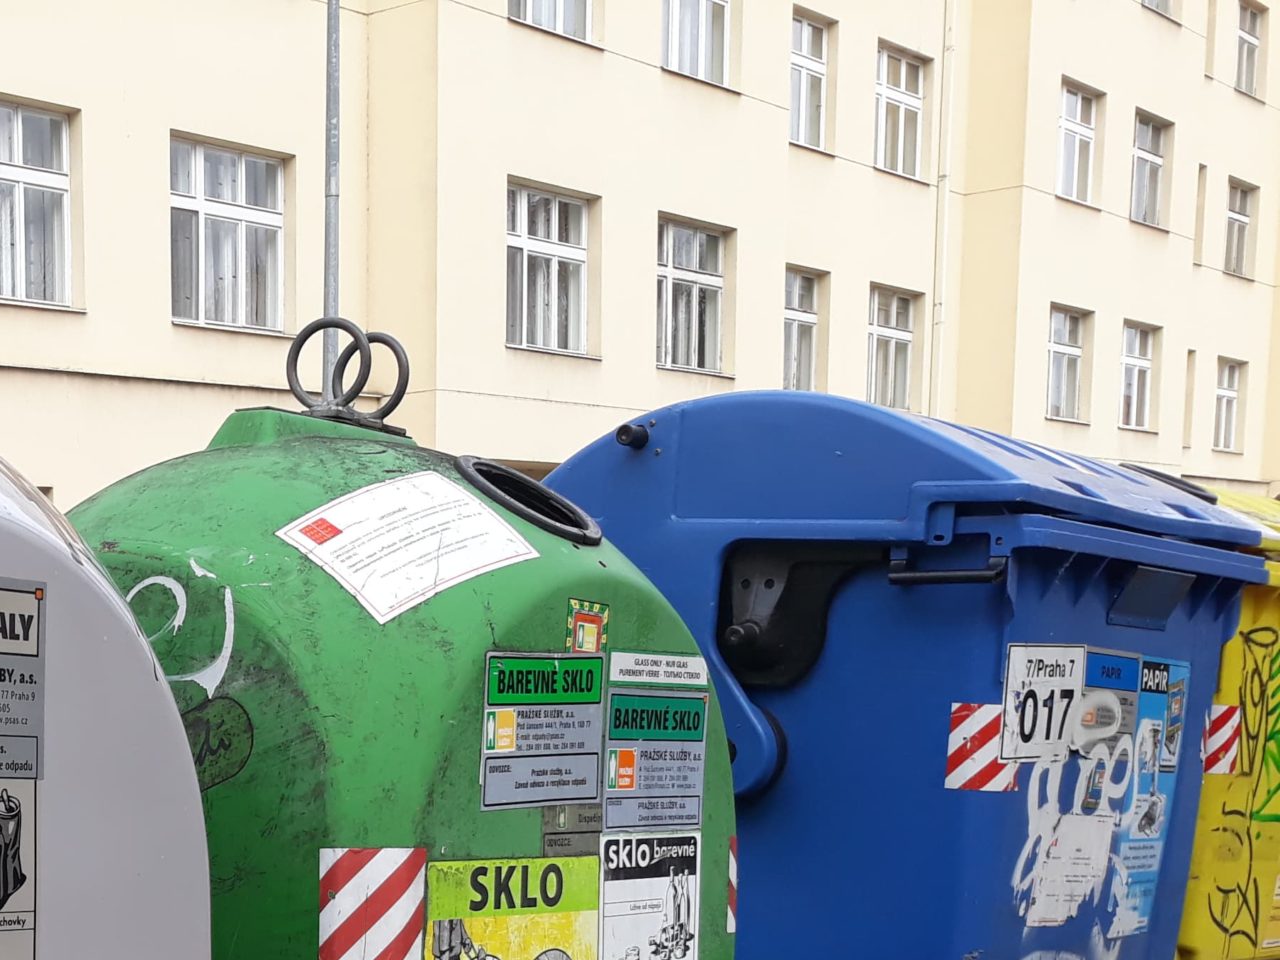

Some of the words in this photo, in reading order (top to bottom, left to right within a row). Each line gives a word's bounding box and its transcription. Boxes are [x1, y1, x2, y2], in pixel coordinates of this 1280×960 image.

[634, 658, 650, 667] GLASS
[650, 659, 662, 667] ONLY
[665, 660, 676, 668] NUR
[676, 660, 688, 669] GLAS
[1026, 659, 1066, 678] 7/Praha
[1069, 659, 1075, 678] 7
[19, 673, 37, 685] a.s.
[497, 666, 558, 694] BAREVNÉ
[562, 668, 594, 694] SKLO
[1142, 664, 1168, 691] PAPÍR
[0, 690, 9, 700] 77
[10, 691, 29, 701] Praha
[30, 692, 36, 702] 9
[614, 706, 669, 731] BAREVNÉ
[671, 710, 700, 731] SKLO
[1020, 689, 1075, 744] 017
[640, 748, 668, 761] PRAŽSKÉ
[668, 748, 692, 762] SLUŽBY,
[4, 759, 33, 773] odpadu
[654, 839, 695, 859] barevné
[469, 863, 564, 912] SKLO
